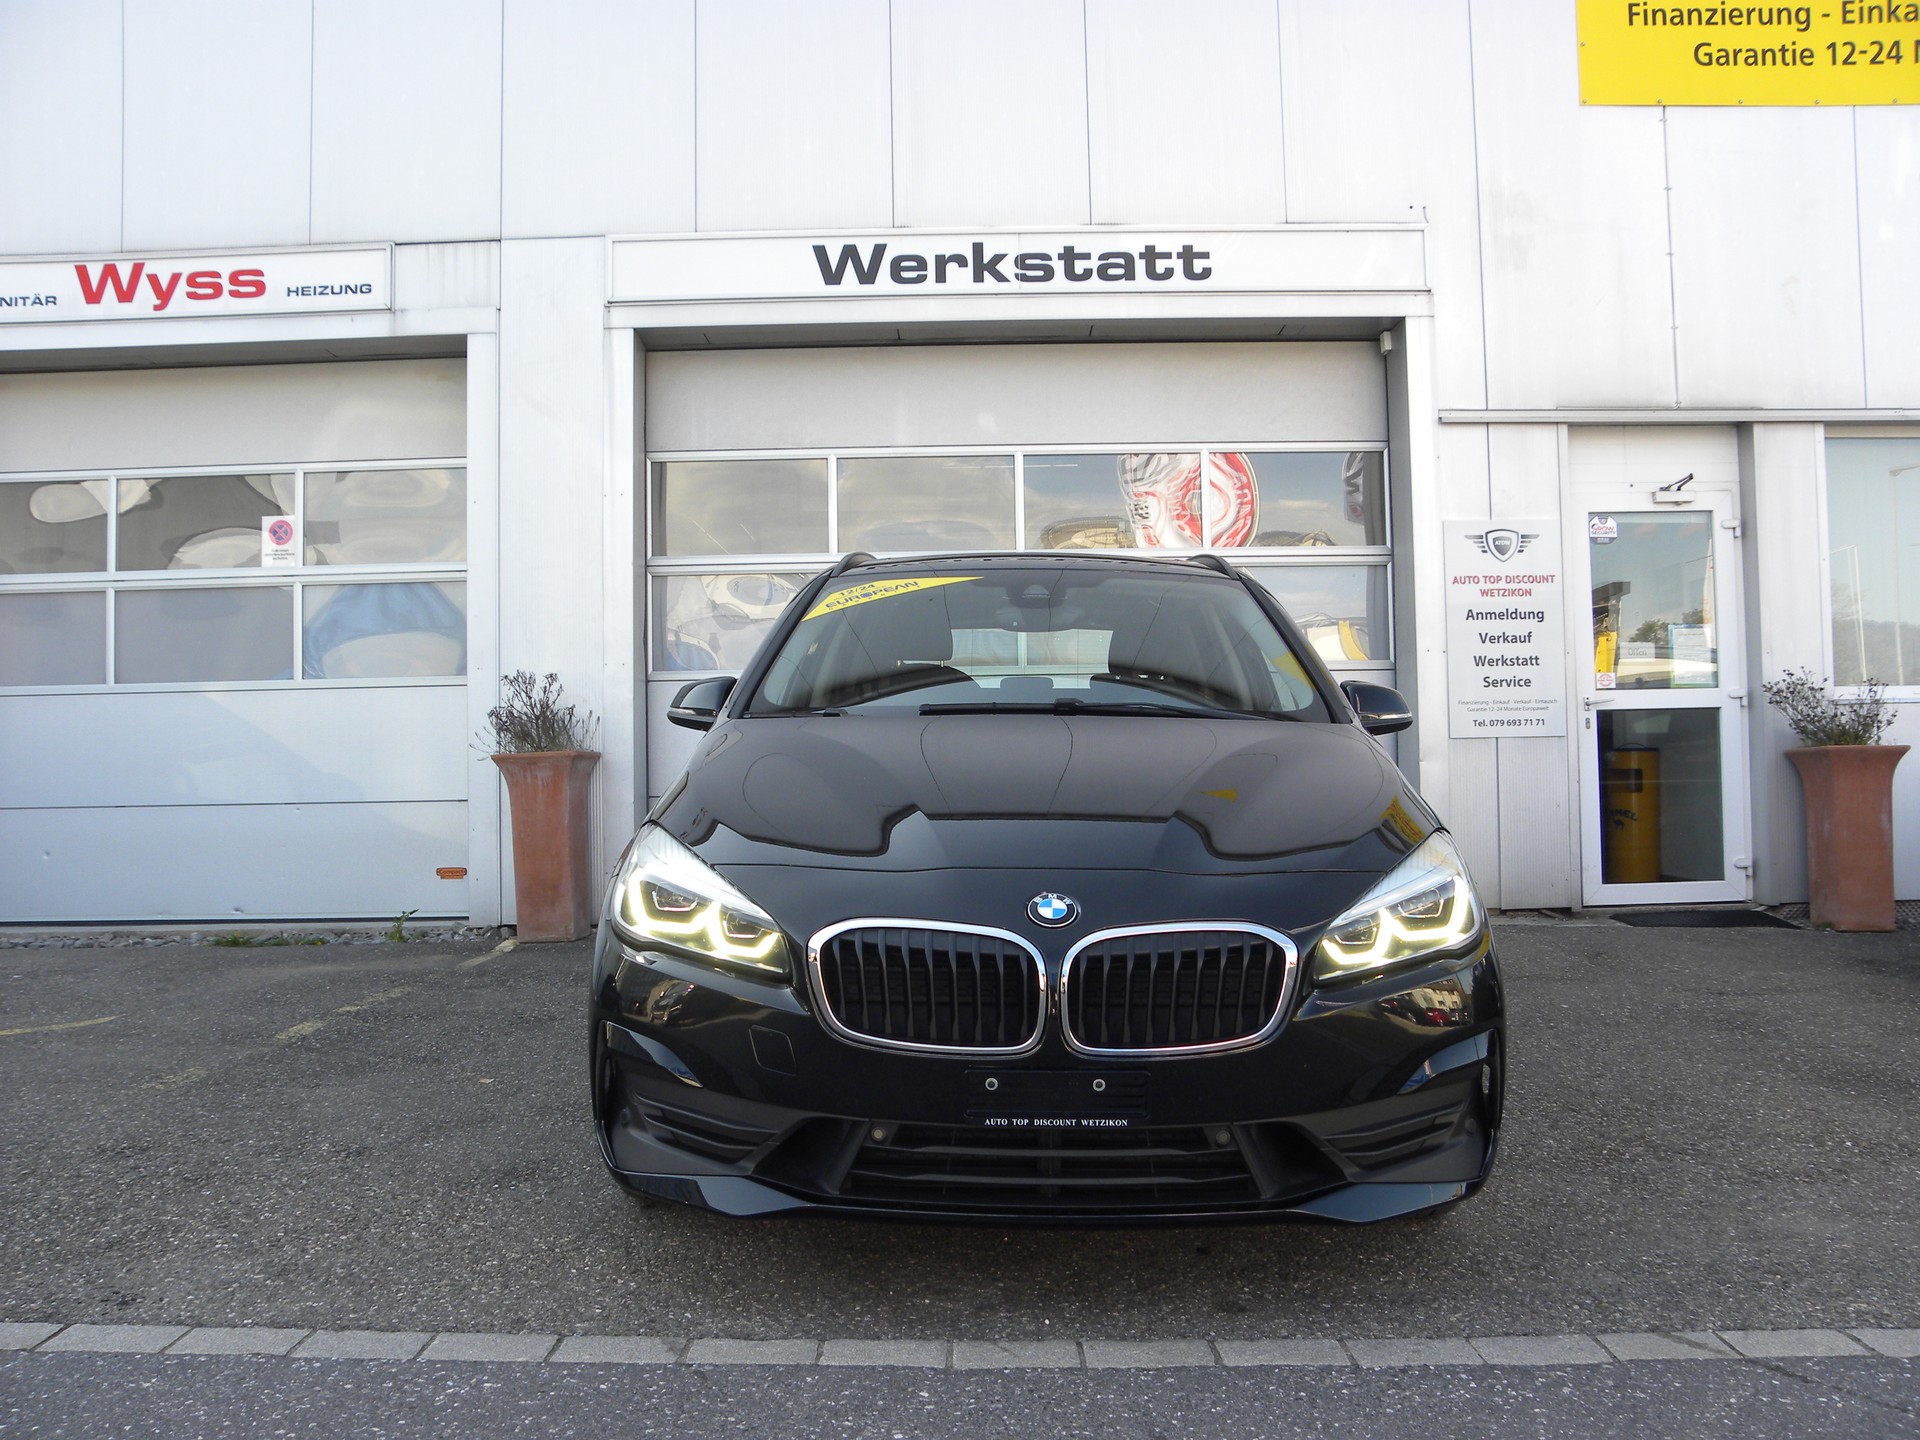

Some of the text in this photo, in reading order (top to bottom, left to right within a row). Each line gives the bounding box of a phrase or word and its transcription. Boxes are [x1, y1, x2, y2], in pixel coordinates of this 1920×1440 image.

[1627, 1, 1811, 32] Finanzierung
[1841, 0, 1919, 24] Einka
[1693, 41, 1815, 67] Garantie
[1826, 40, 1904, 65] 12-24
[812, 242, 1212, 286] Werkstatt
[74, 262, 267, 311] Wyss
[286, 283, 373, 297] HEIZUNG
[1452, 574, 1556, 585] AUTO TOP DISCOUNT
[825, 581, 919, 608] EUROPEAN
[1479, 588, 1532, 597] WETZIKON
[1465, 608, 1545, 623] Anmeldung
[1478, 631, 1533, 644] Verkauf
[1473, 654, 1540, 667] Werkstatt
[1483, 675, 1532, 688] Service
[1473, 719, 1488, 727] Tel.
[1489, 719, 1505, 727] 079
[1535, 718, 1545, 726] 71
[1033, 893, 1074, 905] BMW
[984, 1118, 1008, 1126] AUTO
[1012, 1118, 1029, 1126] TOP
[1081, 1119, 1128, 1127] WETZIKON
